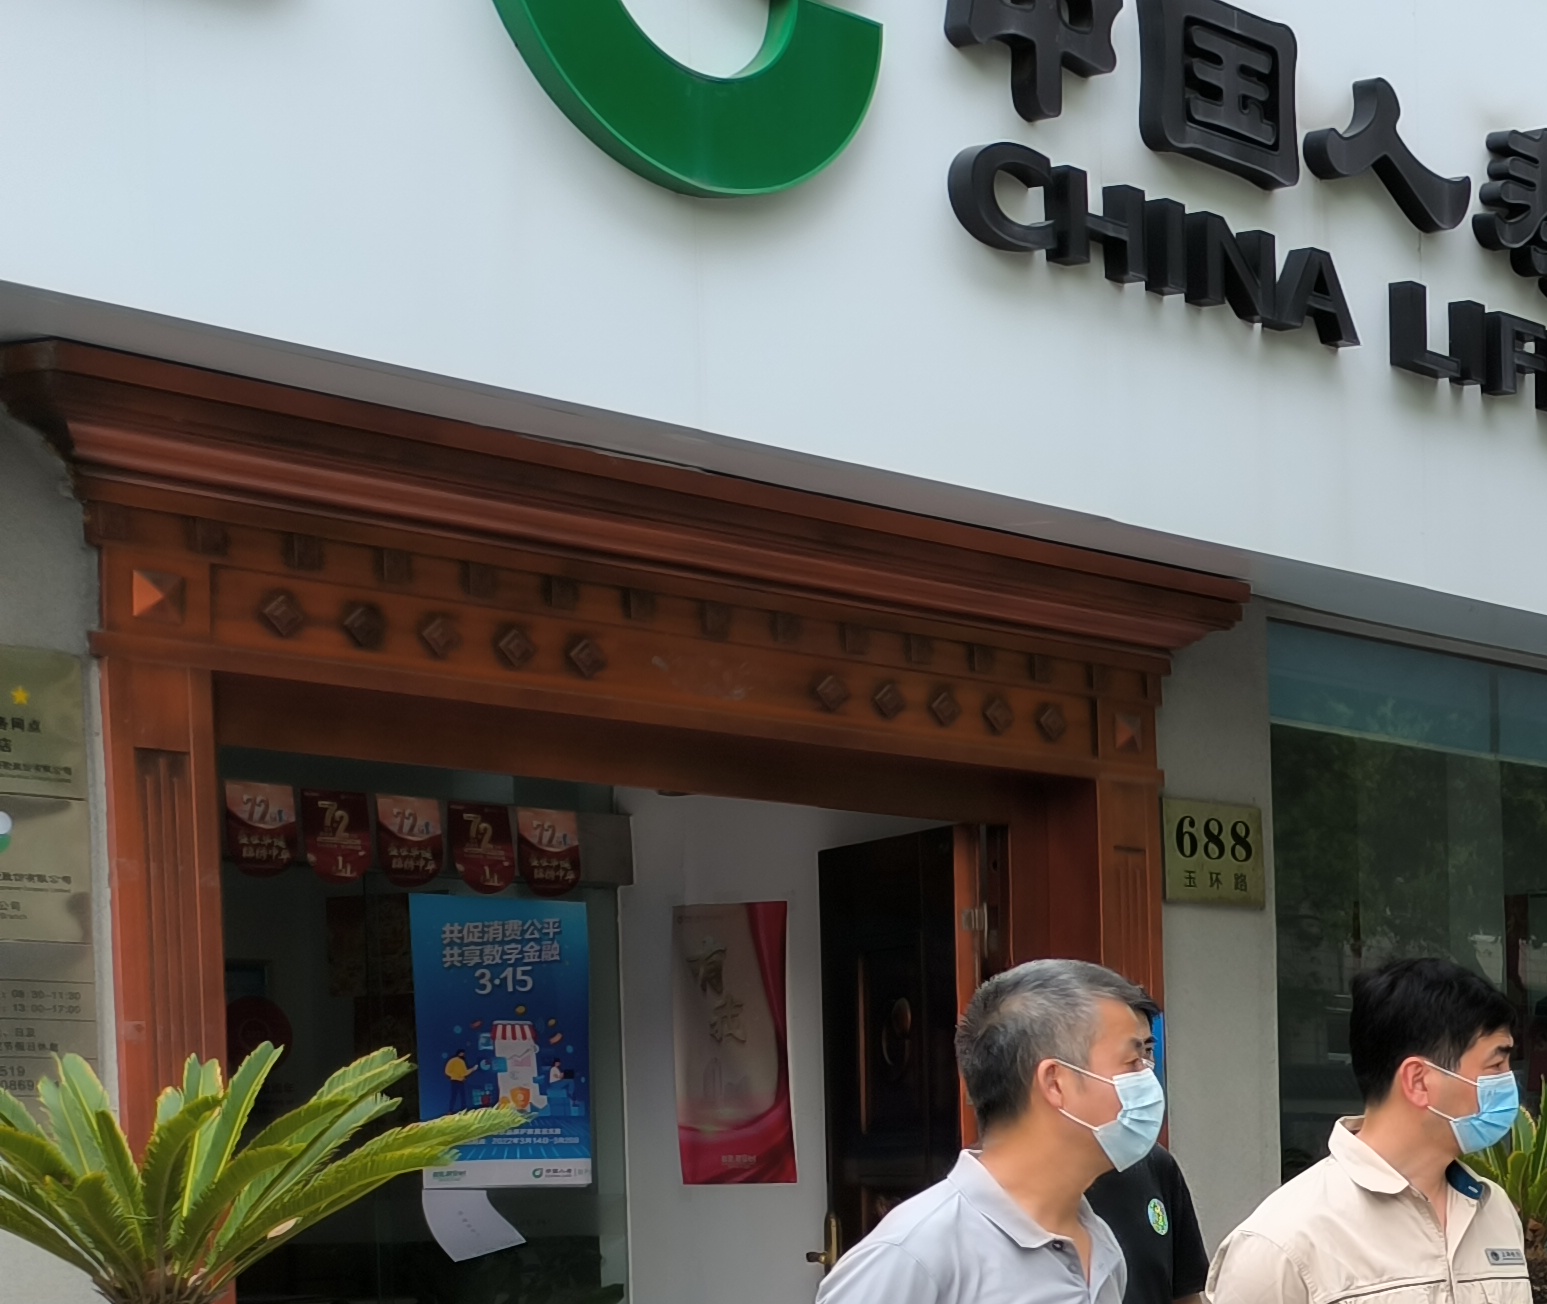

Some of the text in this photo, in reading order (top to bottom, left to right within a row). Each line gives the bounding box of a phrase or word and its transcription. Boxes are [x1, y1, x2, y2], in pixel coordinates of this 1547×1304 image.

[948, 141, 1360, 349] CHINA
[1176, 815, 1253, 863] 688
[441, 918, 562, 944] 共促消费公平
[442, 940, 561, 967] 共享数字金融
